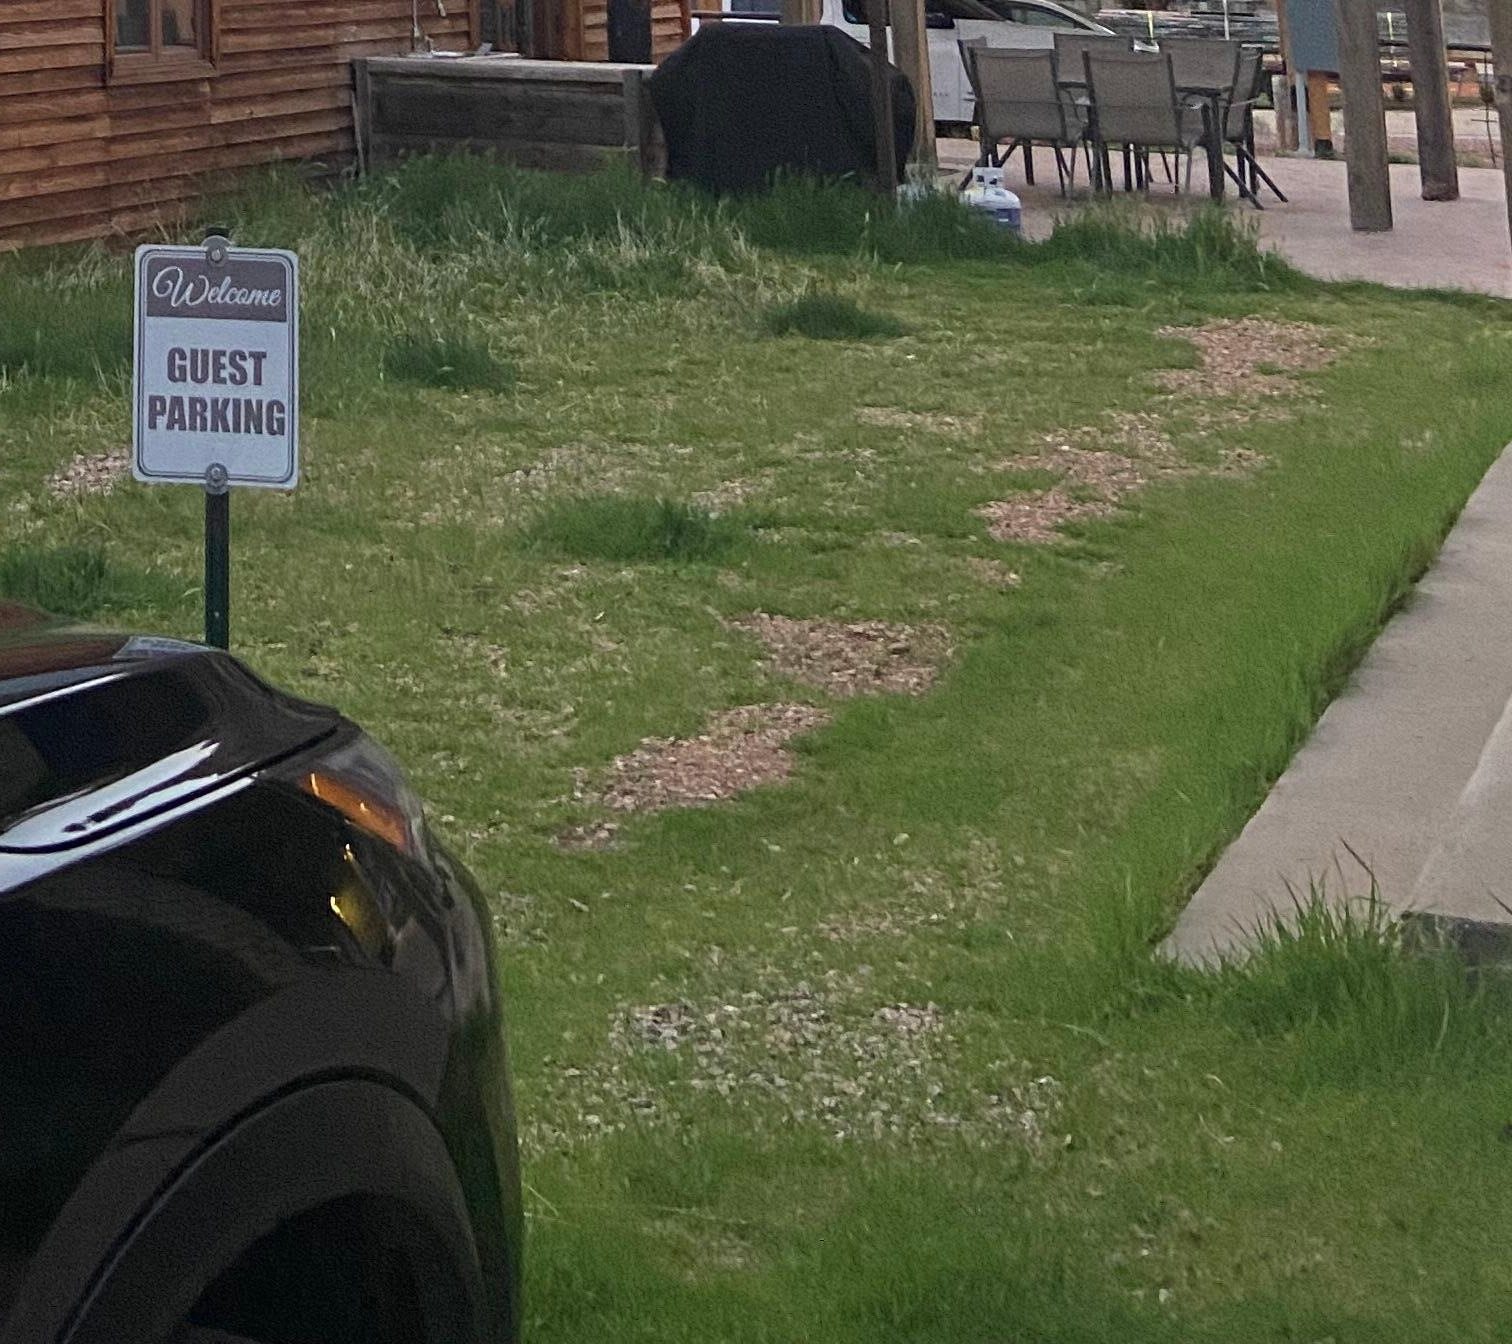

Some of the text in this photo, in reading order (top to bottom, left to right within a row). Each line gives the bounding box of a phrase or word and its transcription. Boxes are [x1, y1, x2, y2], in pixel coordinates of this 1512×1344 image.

[152, 265, 281, 308] Welcome
[167, 347, 267, 386] GUEST
[148, 395, 285, 436] PARKING
